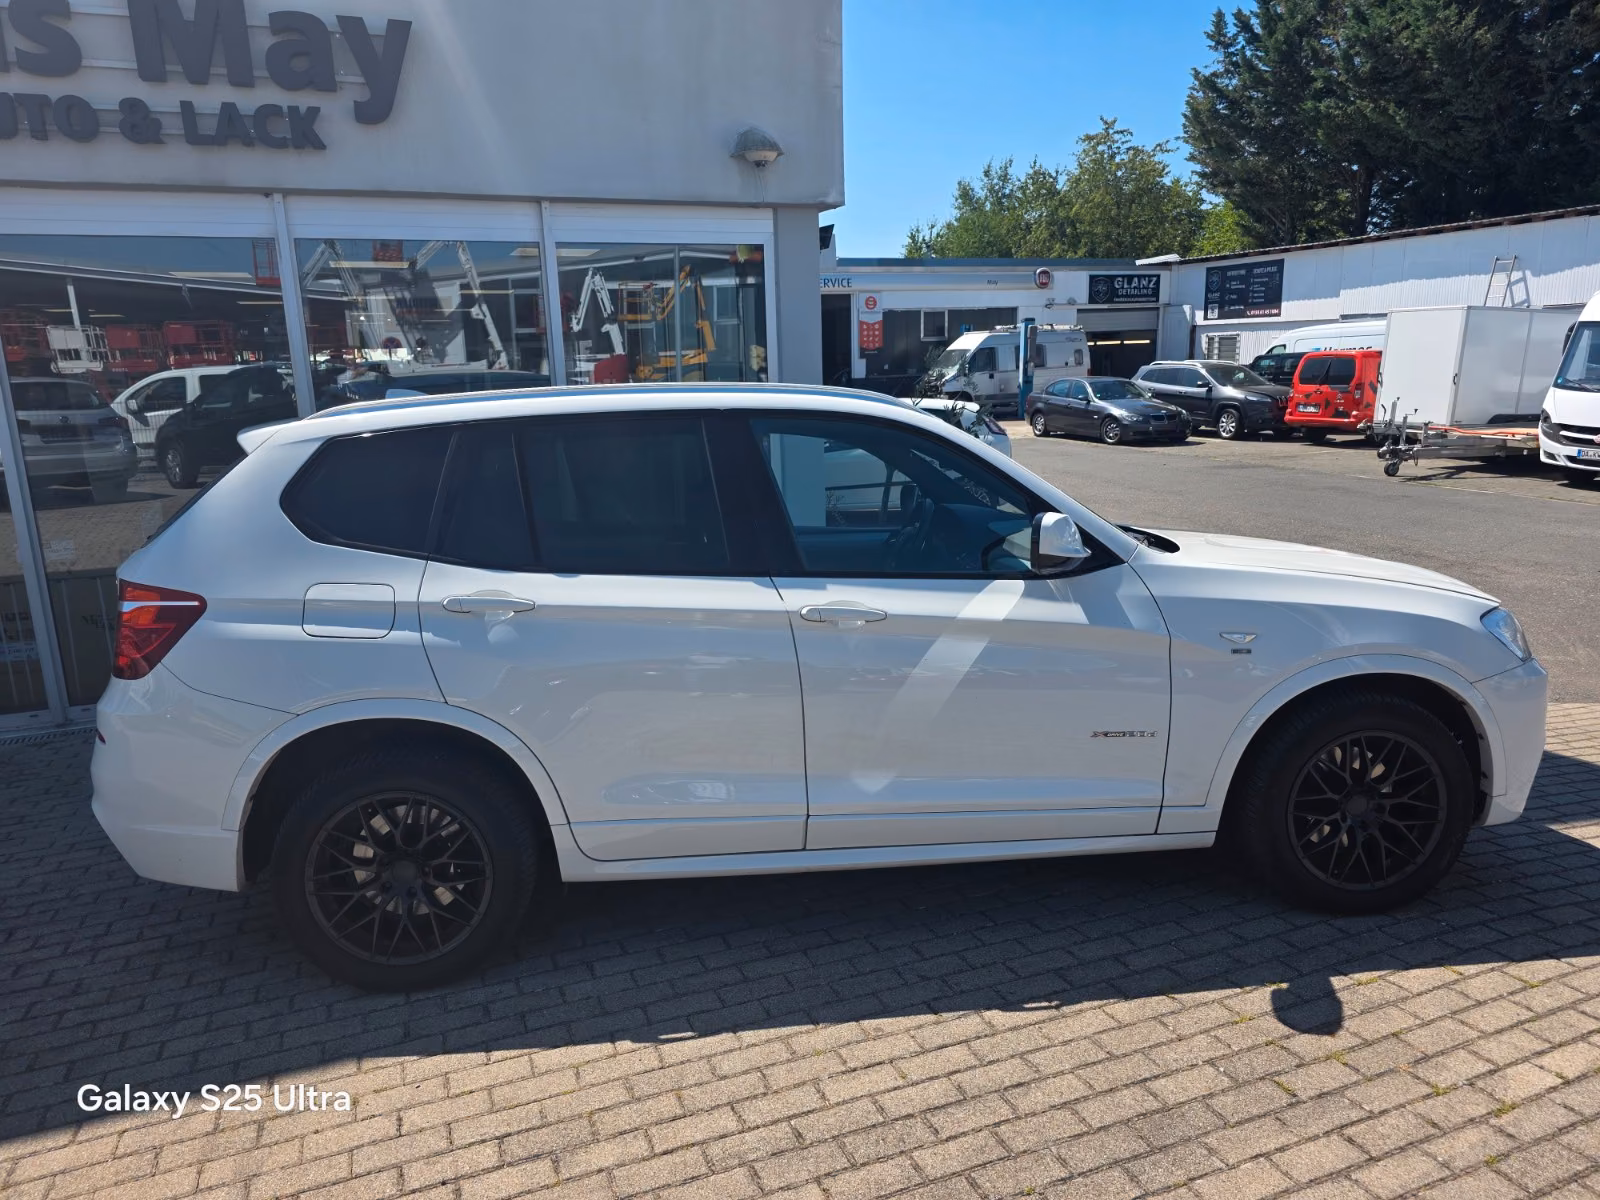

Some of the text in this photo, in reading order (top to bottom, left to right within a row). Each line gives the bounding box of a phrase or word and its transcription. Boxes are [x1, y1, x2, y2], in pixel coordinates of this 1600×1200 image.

[127, 0, 412, 124] May
[118, 98, 165, 144] &
[179, 100, 326, 150] LACK
[1114, 276, 1158, 289] GLANZ
